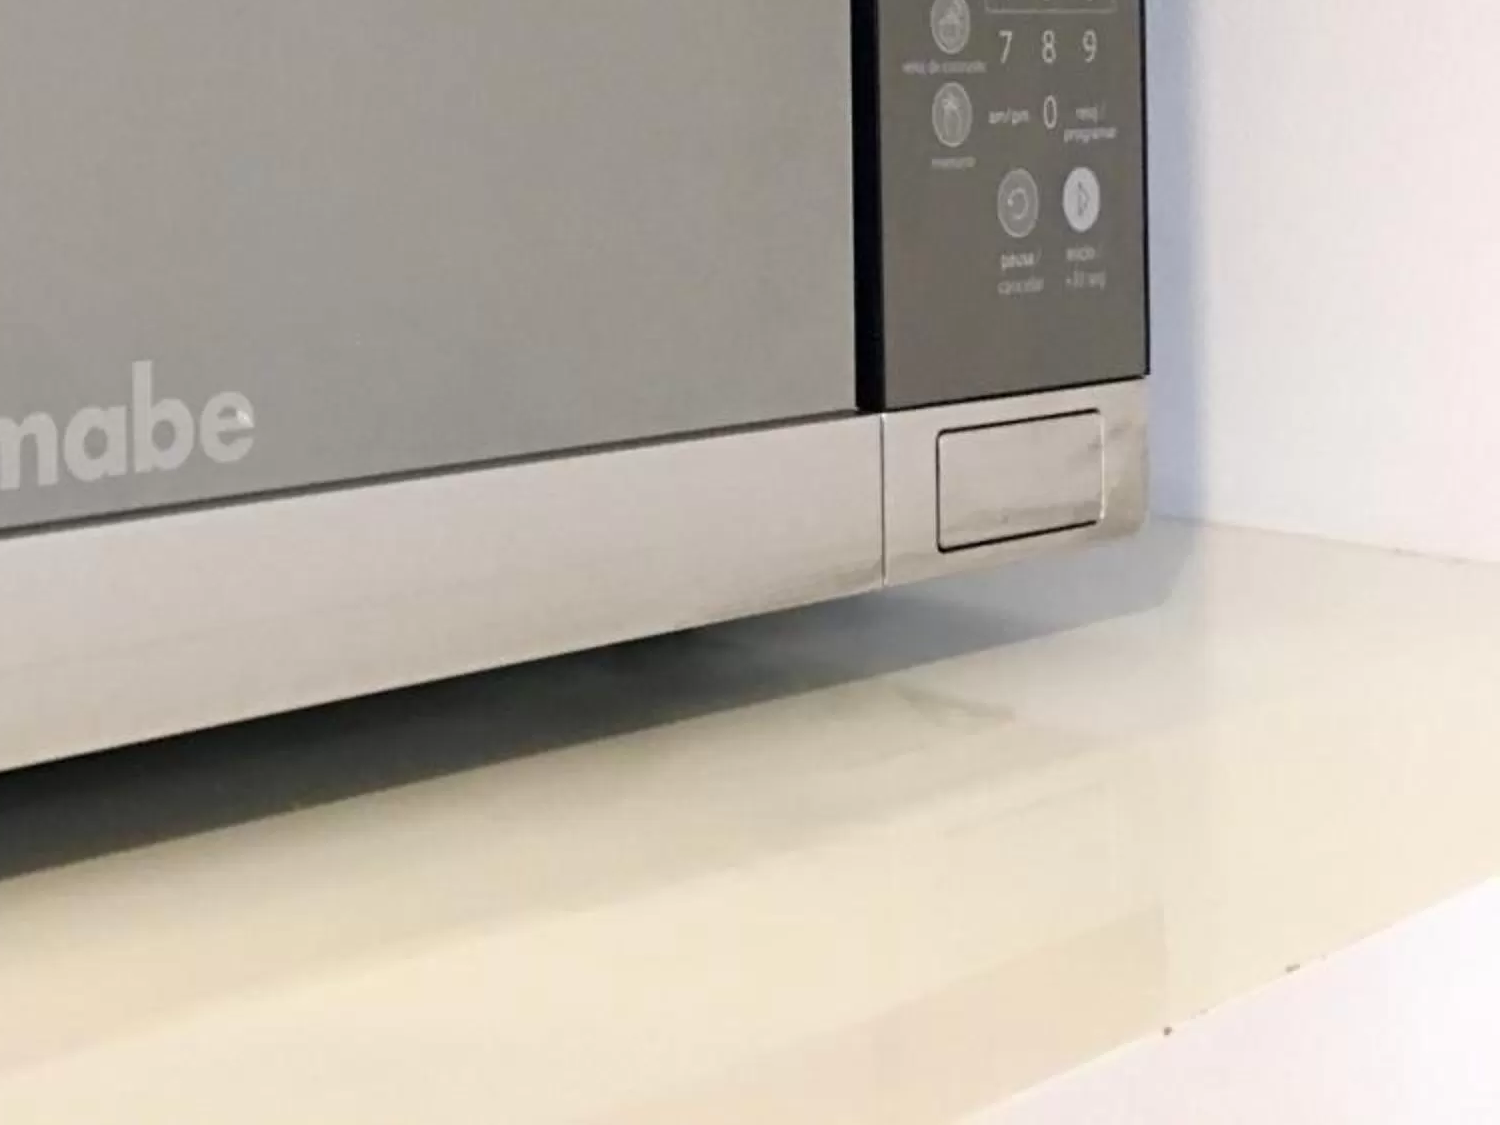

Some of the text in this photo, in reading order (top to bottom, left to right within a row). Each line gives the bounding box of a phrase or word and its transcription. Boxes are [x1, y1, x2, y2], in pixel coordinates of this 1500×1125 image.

[999, 29, 1098, 64] 7 8 9
[1043, 94, 1058, 130] 0
